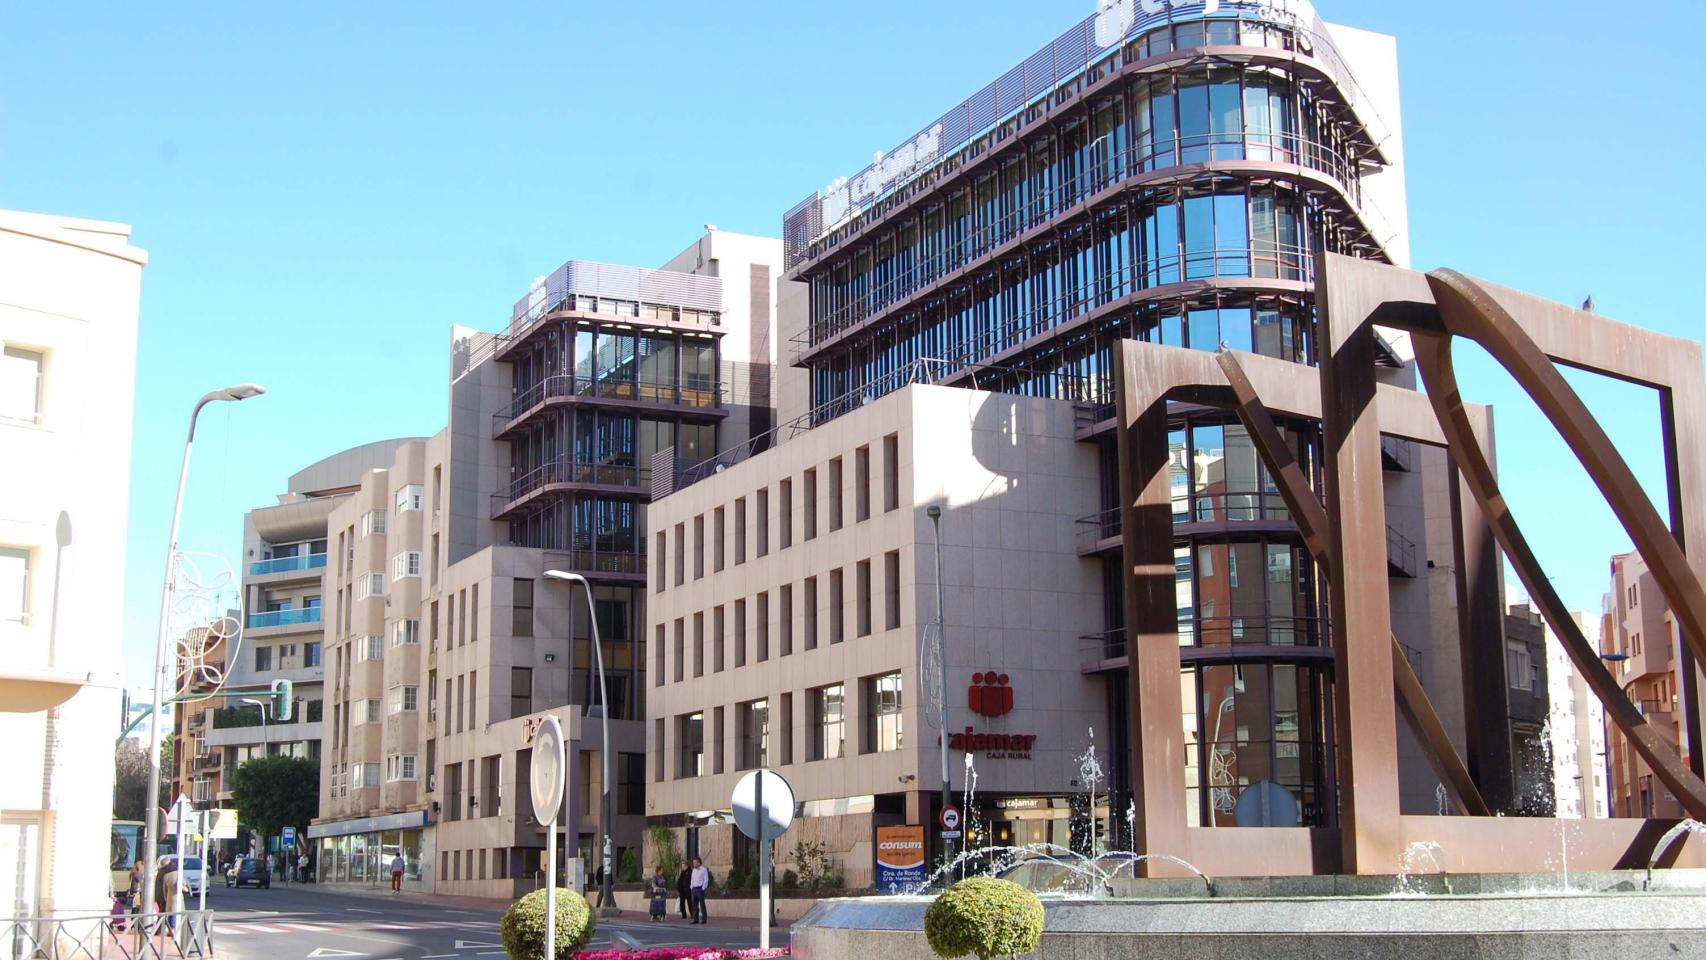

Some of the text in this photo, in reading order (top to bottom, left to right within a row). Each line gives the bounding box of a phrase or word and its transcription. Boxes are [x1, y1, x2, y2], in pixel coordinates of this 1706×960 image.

[986, 752, 1033, 760] CAJA RURAL
[1006, 798, 1038, 809] cajamar
